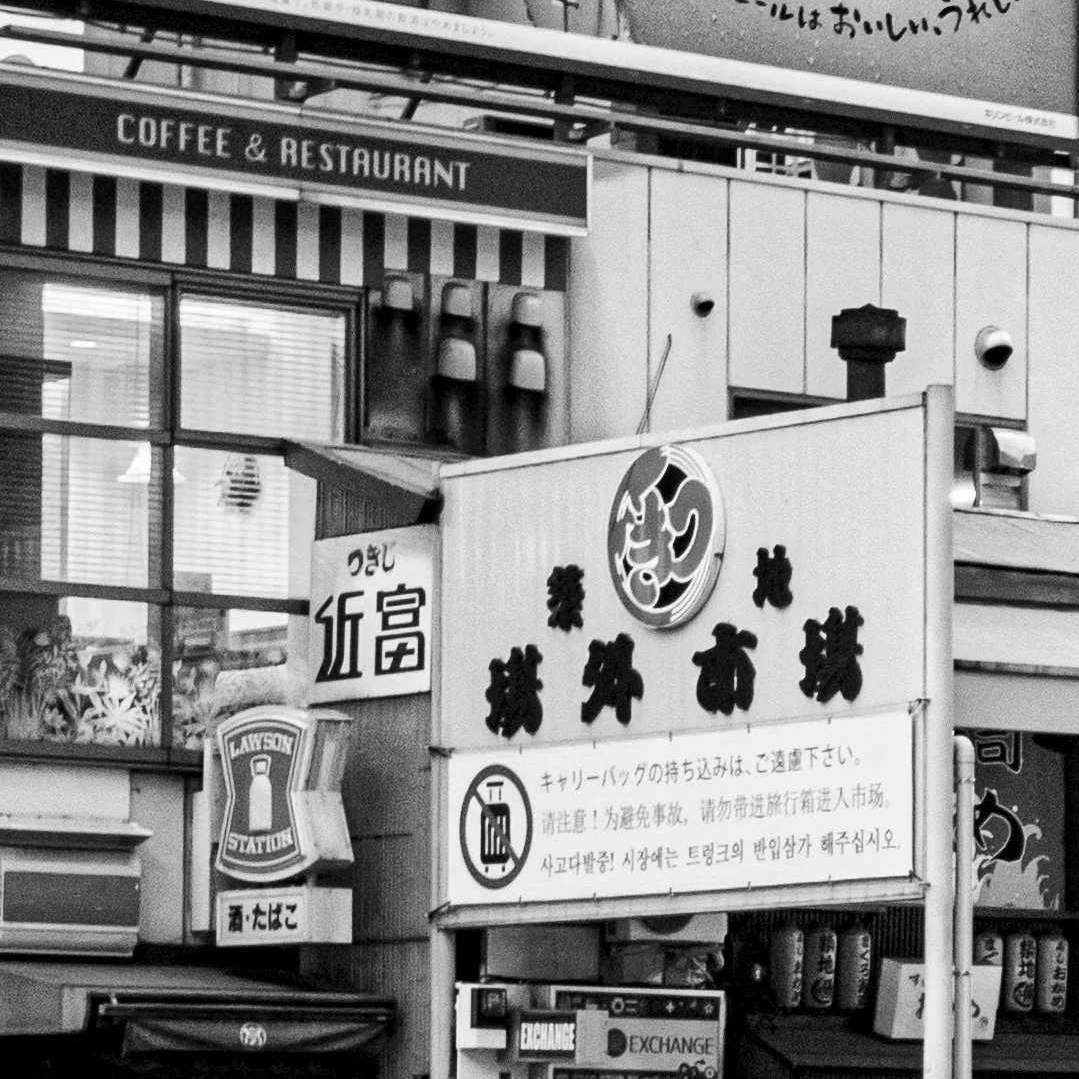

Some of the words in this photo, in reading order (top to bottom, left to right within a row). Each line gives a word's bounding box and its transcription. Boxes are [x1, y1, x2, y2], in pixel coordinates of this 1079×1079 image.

[116, 114, 232, 159] COFFEE
[244, 133, 267, 163] &
[280, 136, 471, 190] RESTAURANT
[347, 542, 397, 577] つきじ
[315, 583, 427, 684] 近富
[229, 732, 294, 760] LAWSON
[539, 744, 862, 794] キャリーバッグの持ち込みは、ご遠慮下さい。
[227, 827, 293, 854] STATION
[621, 845, 679, 872] 시장에는
[685, 839, 744, 866] 트렁크의
[228, 903, 298, 933] 酒・たばこ
[520, 1022, 575, 1051] EXCHANGE
[628, 1034, 716, 1057] EXCHANGE
